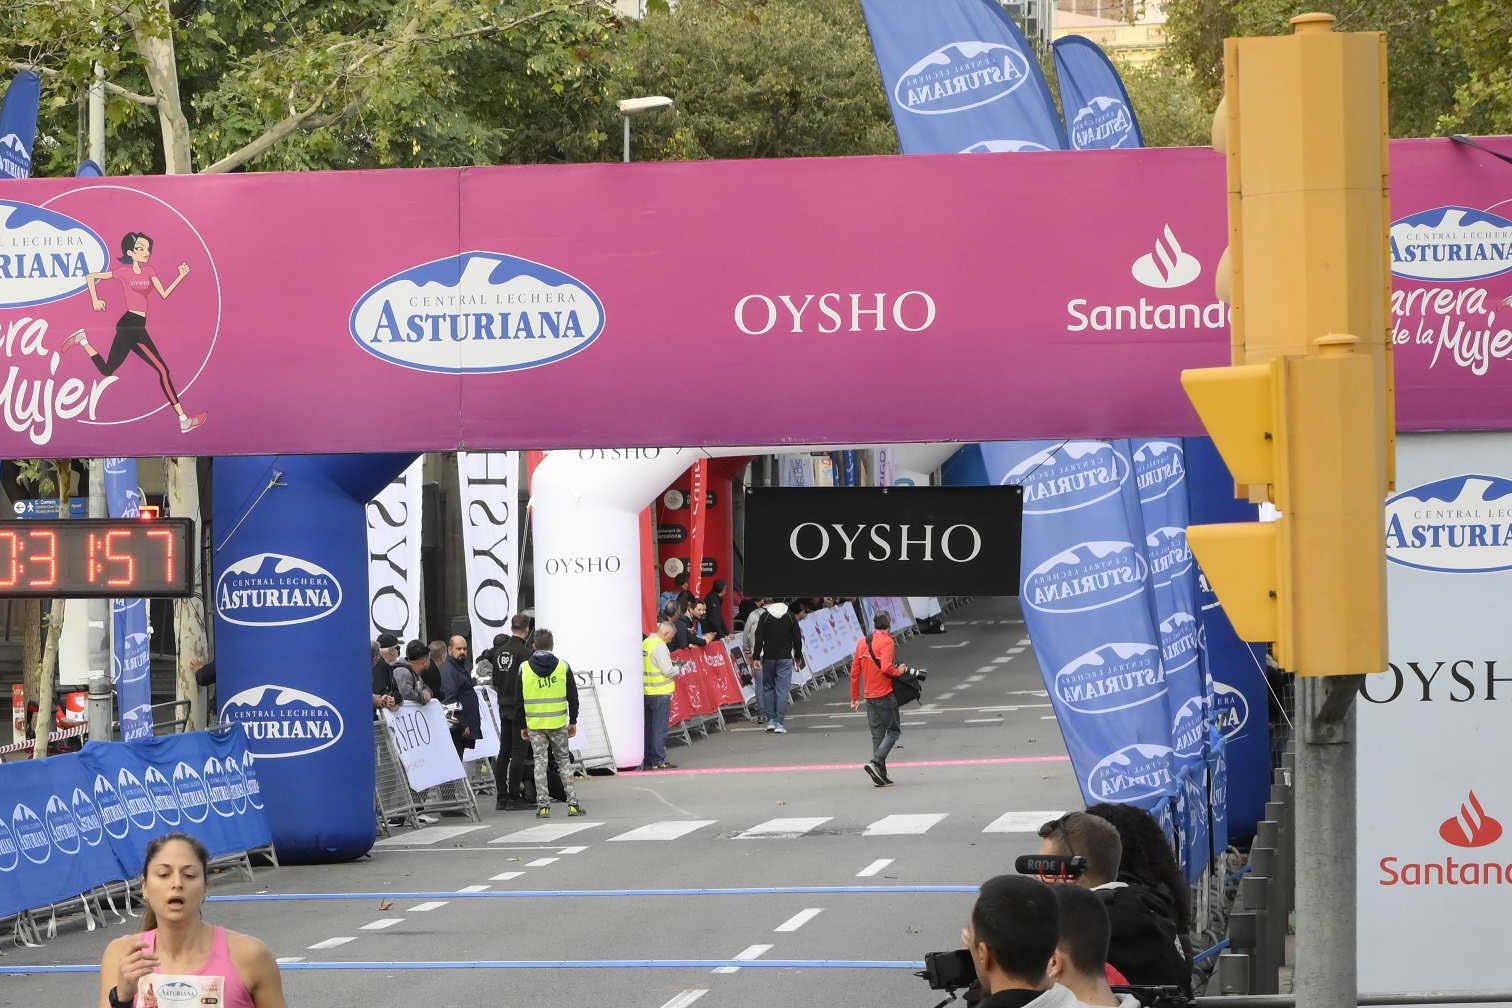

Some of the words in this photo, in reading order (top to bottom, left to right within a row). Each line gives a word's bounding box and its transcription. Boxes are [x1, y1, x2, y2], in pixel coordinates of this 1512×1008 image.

[11, 236, 84, 247] LECHERA
[409, 294, 488, 308] CENTRAL
[496, 293, 577, 304] LECHERA
[733, 290, 938, 337] OYSHO
[1066, 297, 1232, 332] Santand
[1392, 287, 1489, 316] arrera
[370, 299, 586, 343] ASTURIANA
[1415, 318, 1435, 345] la
[1429, 311, 1512, 376] Muje
[1413, 509, 1481, 520] CENTRAL
[466, 451, 510, 628] OYSH
[789, 521, 982, 563] OYSHO
[1386, 512, 1512, 549] ASTURI
[367, 473, 409, 638] OYS
[545, 555, 621, 576] OYSHO
[219, 582, 333, 611] ASTURIANA
[232, 577, 275, 587] CENTRAL
[279, 577, 328, 586] LECHERA
[576, 668, 623, 687] SHO
[1359, 660, 1512, 704] OYSH
[225, 713, 334, 740] TURIANA
[235, 710, 276, 719] CENTRAL
[280, 709, 329, 718] LECHERA
[394, 710, 431, 754] SHO
[1378, 856, 1512, 886] Santan
